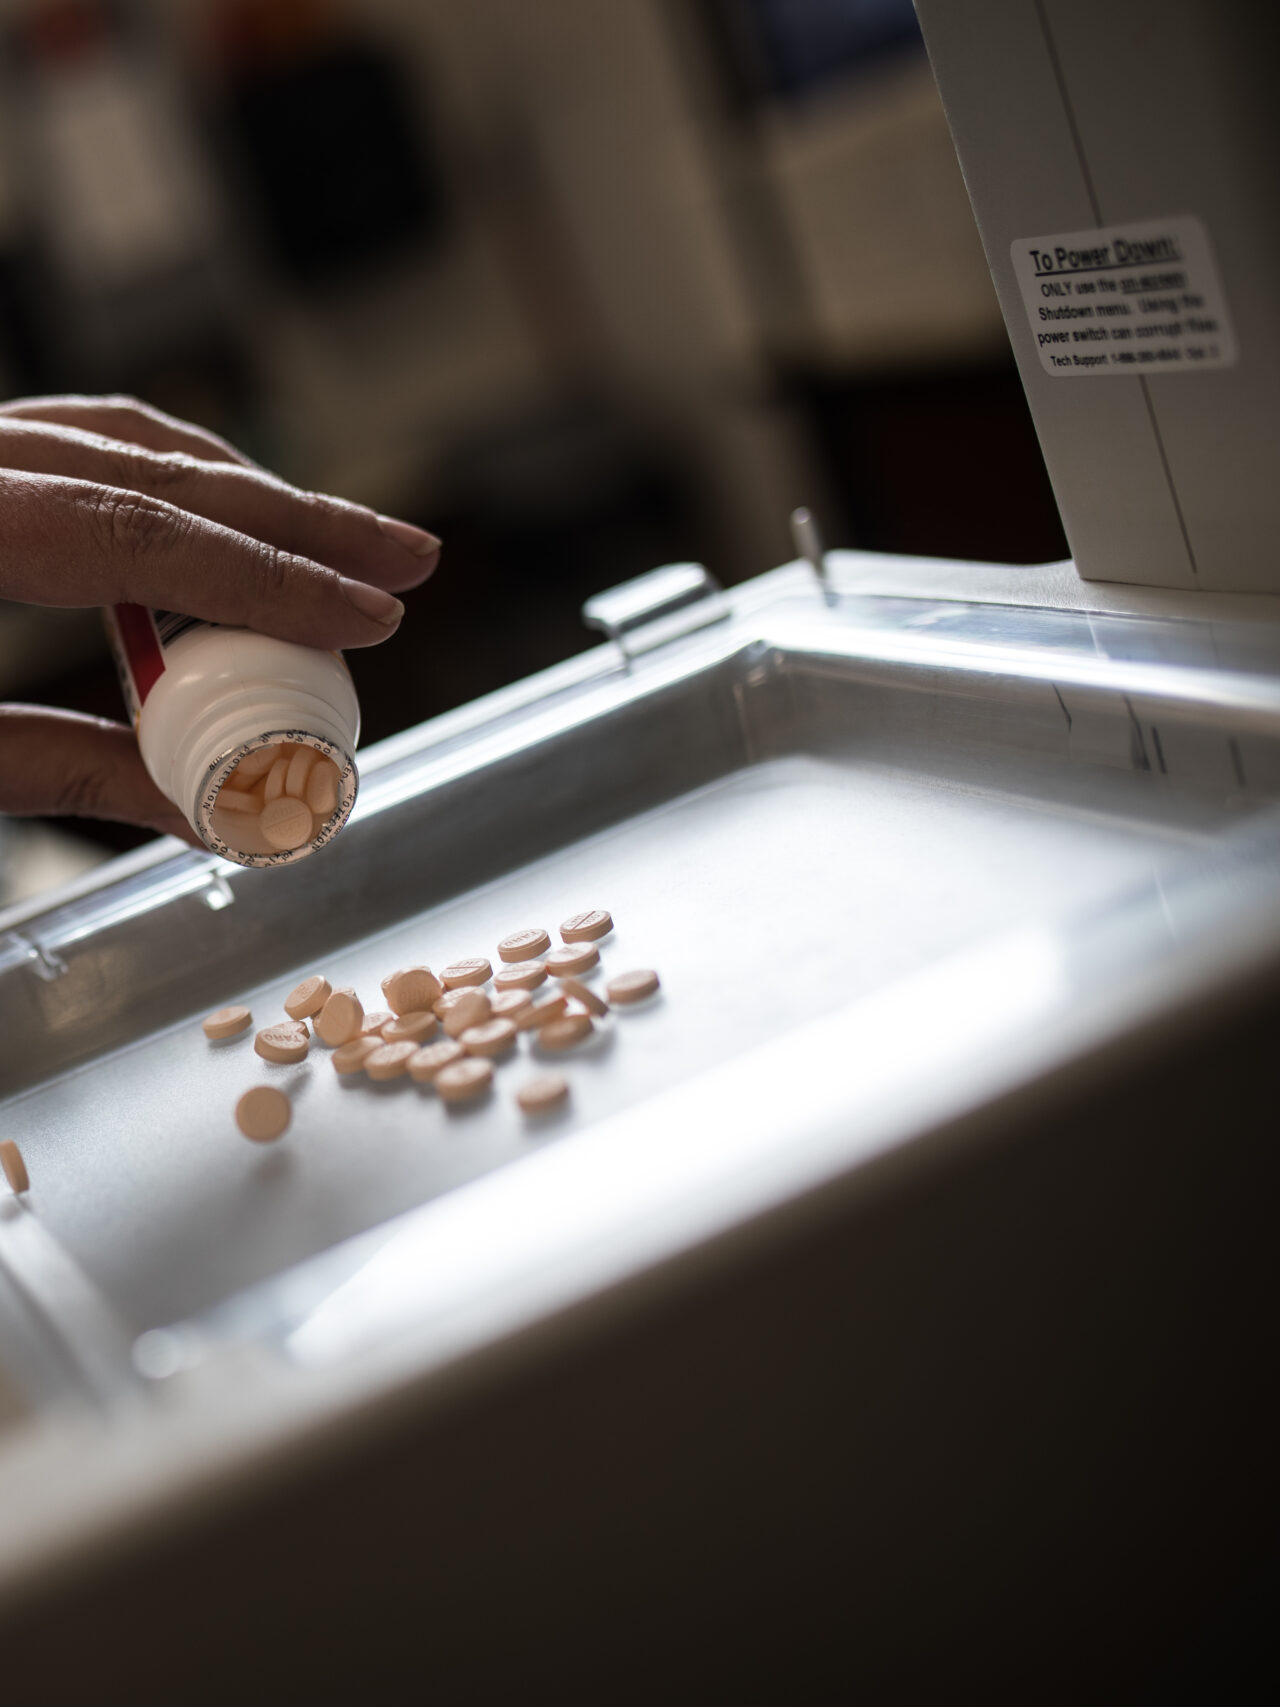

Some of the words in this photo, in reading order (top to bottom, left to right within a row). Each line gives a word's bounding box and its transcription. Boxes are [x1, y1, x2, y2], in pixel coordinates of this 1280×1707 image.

[1029, 250, 1053, 271] To
[1054, 247, 1109, 268] Power
[1113, 236, 1182, 263] Down:
[1041, 281, 1072, 297] ONLY
[1076, 282, 1096, 294] use
[1098, 279, 1117, 291] the
[1038, 304, 1093, 321] Shutdown
[1037, 331, 1070, 347] power
[1072, 328, 1108, 341] switch
[1111, 327, 1131, 339] can
[1050, 355, 1072, 367] Tech
[1073, 353, 1107, 367] Support
[203, 745, 250, 809] PROTECTION
[264, 1033, 302, 1042] TARO
